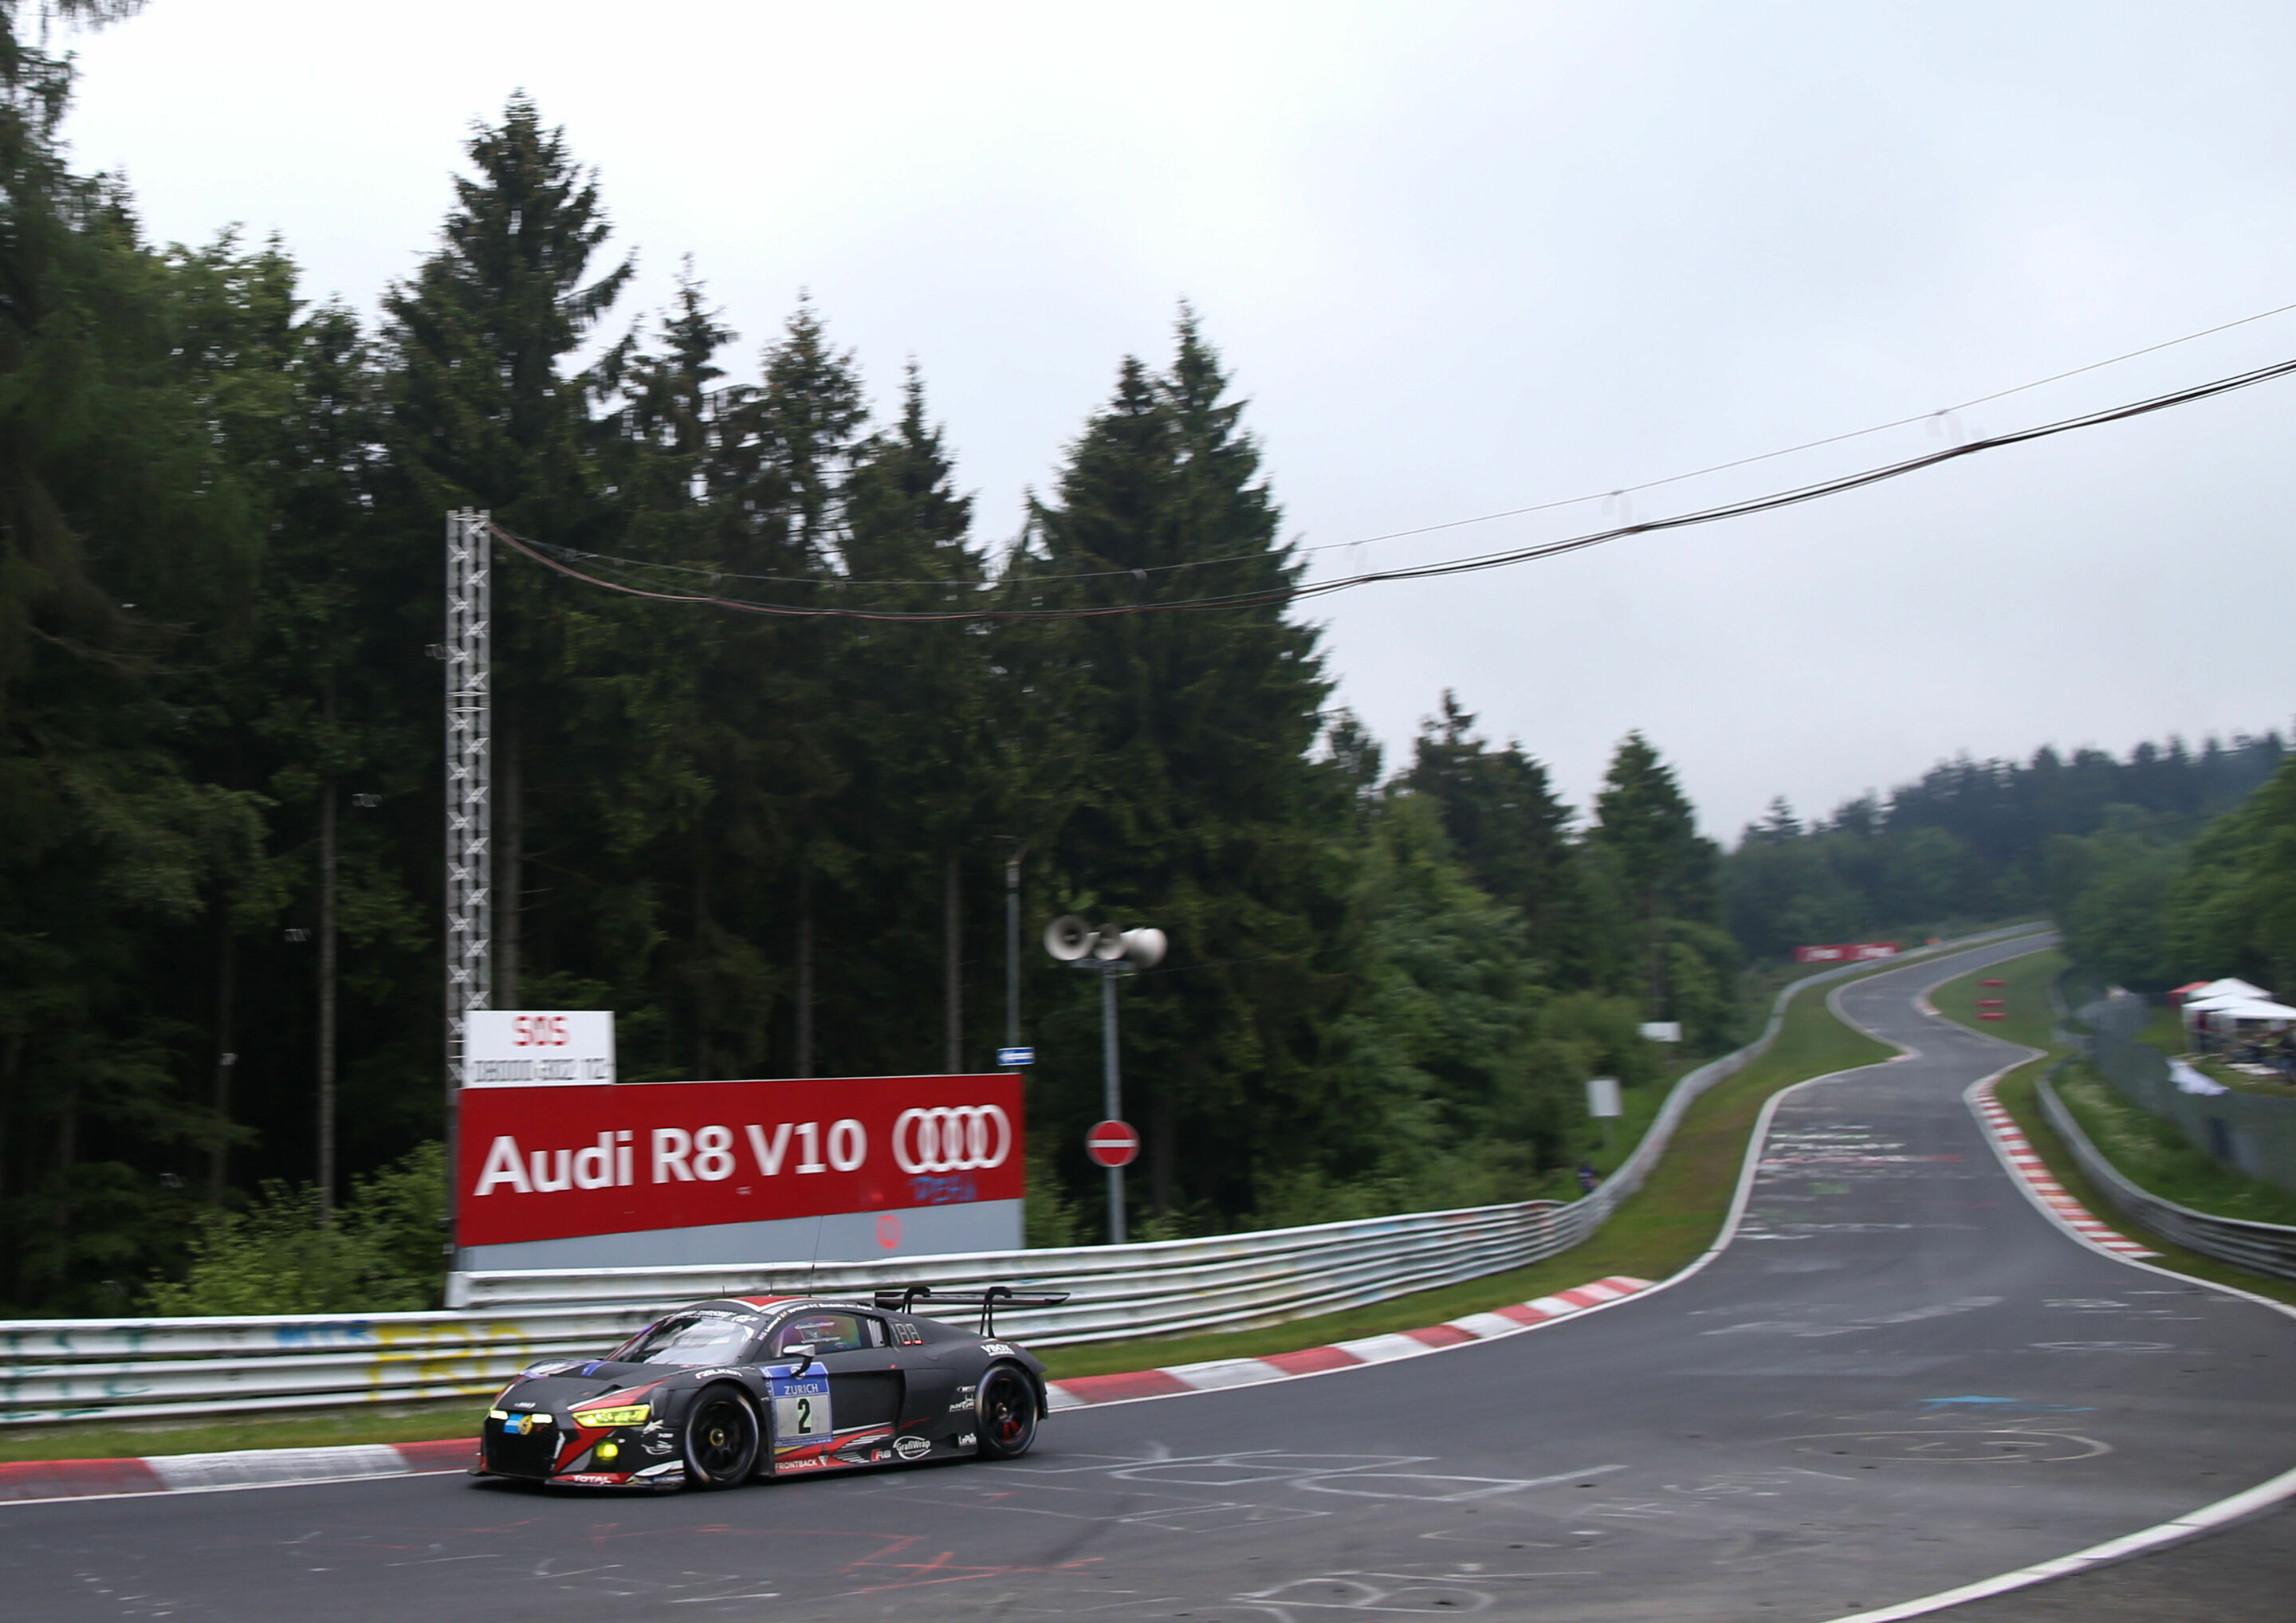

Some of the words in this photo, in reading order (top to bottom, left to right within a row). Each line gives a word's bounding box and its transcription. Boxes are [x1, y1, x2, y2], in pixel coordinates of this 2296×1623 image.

[513, 1016, 569, 1046] SOS
[474, 1130, 634, 1197] Audi
[651, 1125, 736, 1184] R8
[745, 1118, 867, 1177] V10
[981, 1344, 1012, 1354] VBOX
[784, 1383, 819, 1395] ZURICH
[797, 1398, 811, 1434] 2
[897, 1440, 931, 1452] GrafiWrap
[775, 1459, 818, 1470] FRONTBACK
[572, 1474, 612, 1485] TOTAL
